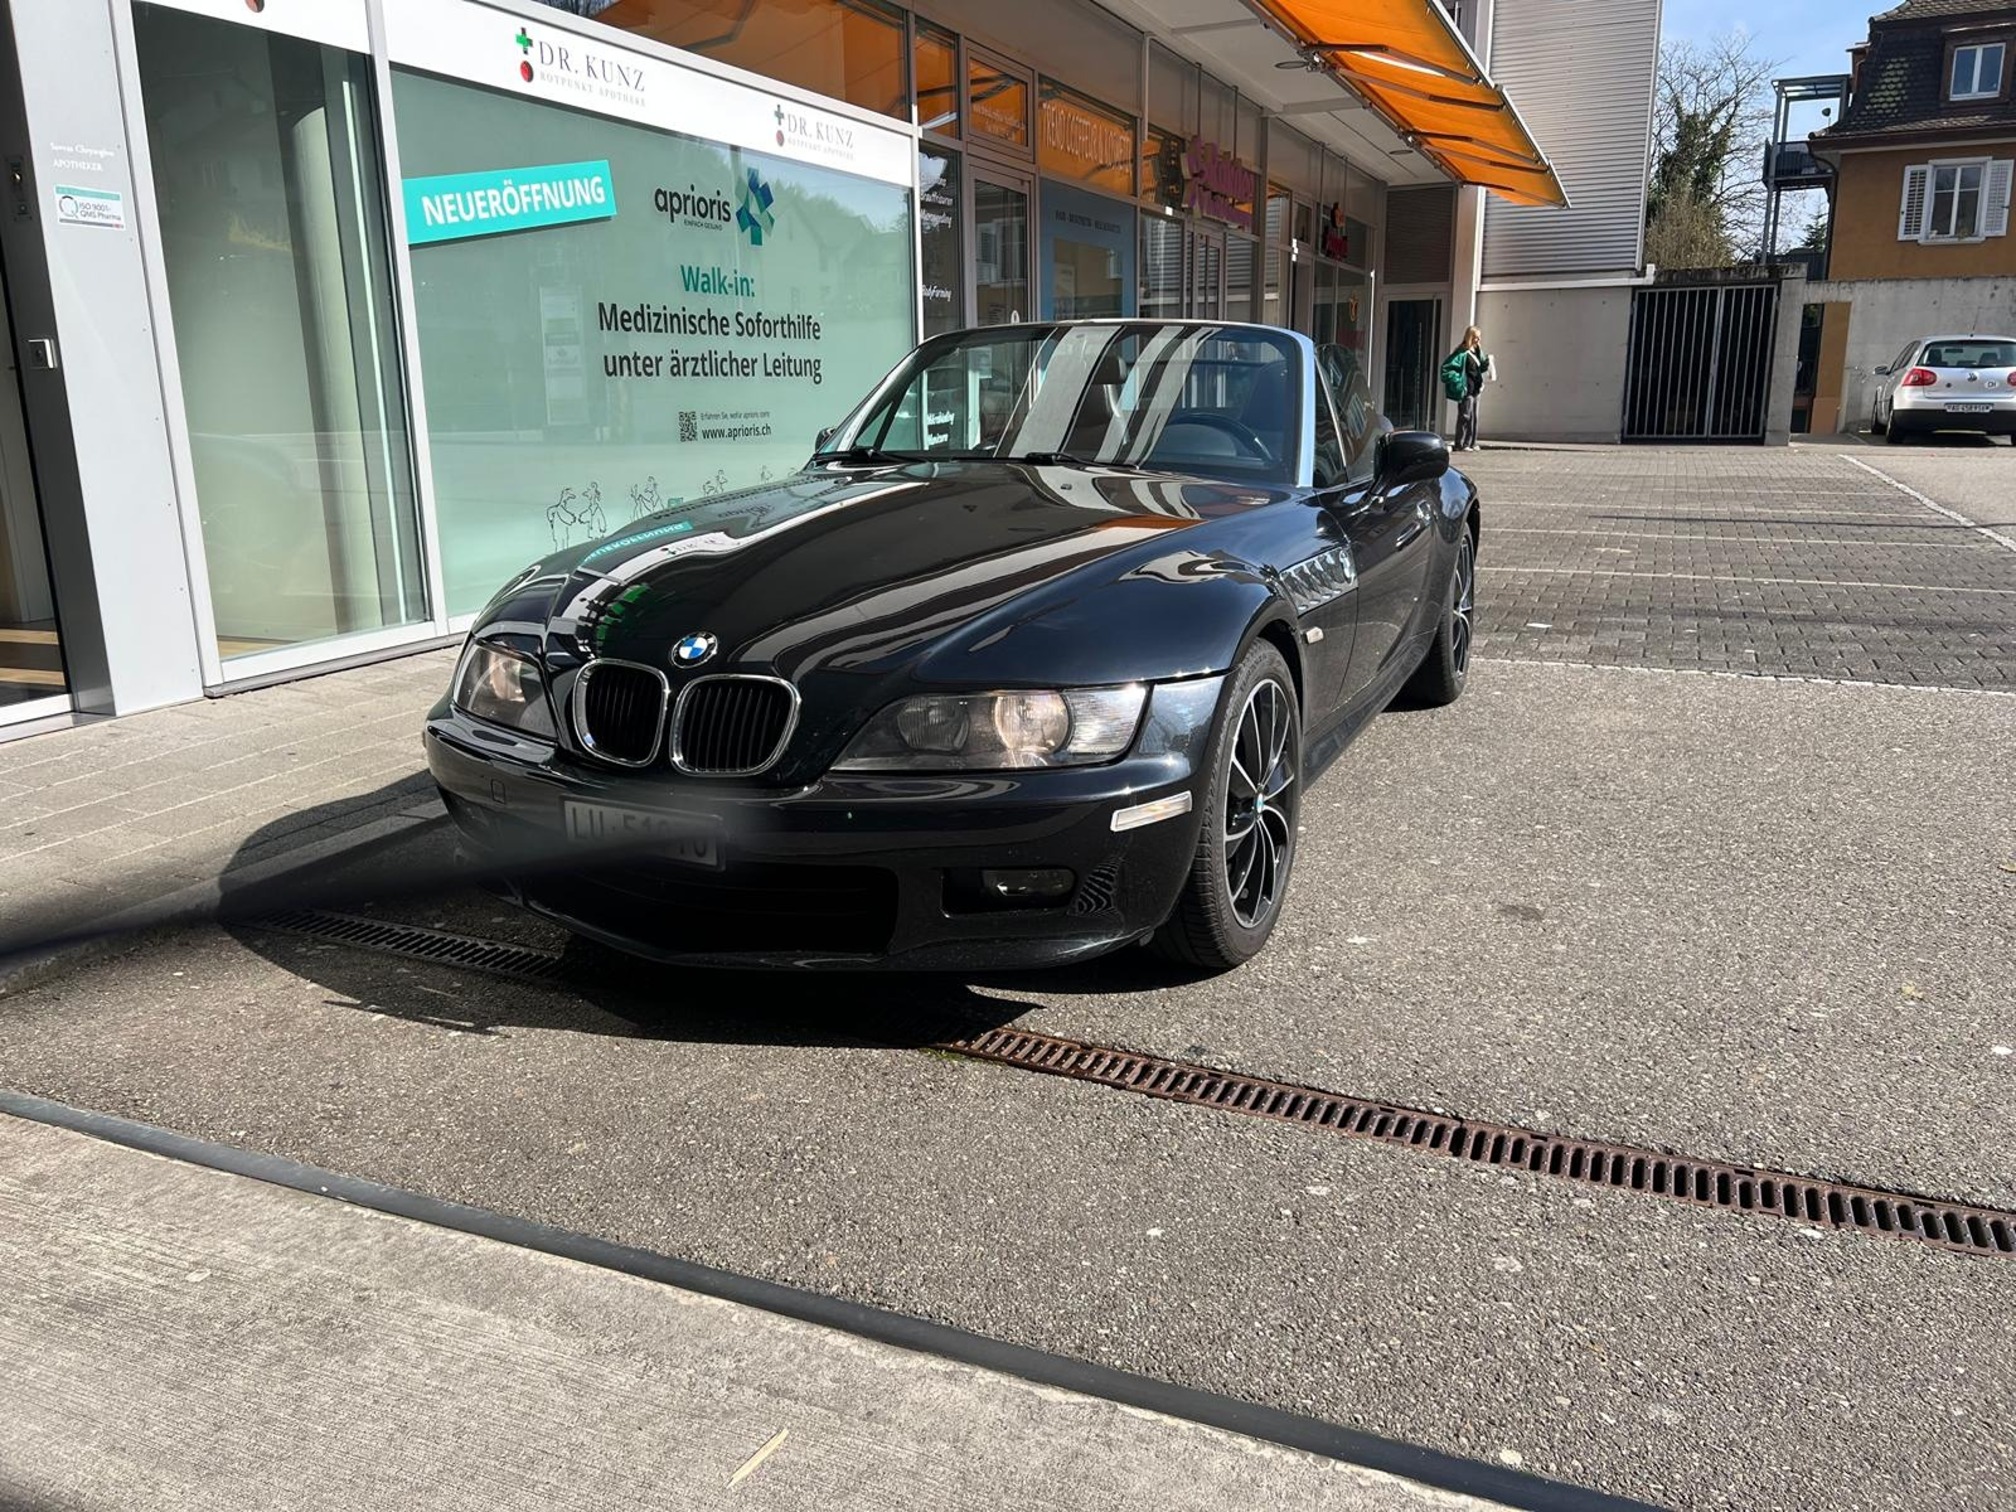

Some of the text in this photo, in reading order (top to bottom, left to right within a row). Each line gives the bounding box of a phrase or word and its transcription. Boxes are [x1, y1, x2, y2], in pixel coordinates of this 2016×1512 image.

[539, 41, 645, 92] DR. KUNZ
[540, 72, 646, 107] ROTPUNKT APOTHEKE
[787, 114, 854, 149] DR. KUNZ
[53, 158, 103, 172] APOTHEKER
[80, 210, 122, 221] QMS Pharma
[420, 175, 606, 226] NEUERÖFFNUNG
[654, 184, 731, 223] aprioris
[680, 264, 755, 297] Walk-in:
[598, 302, 821, 341] Medizinische Soforthilfe
[604, 350, 823, 385] unter ärztlicher Leitung
[701, 423, 772, 441] www.aprioris.ch
